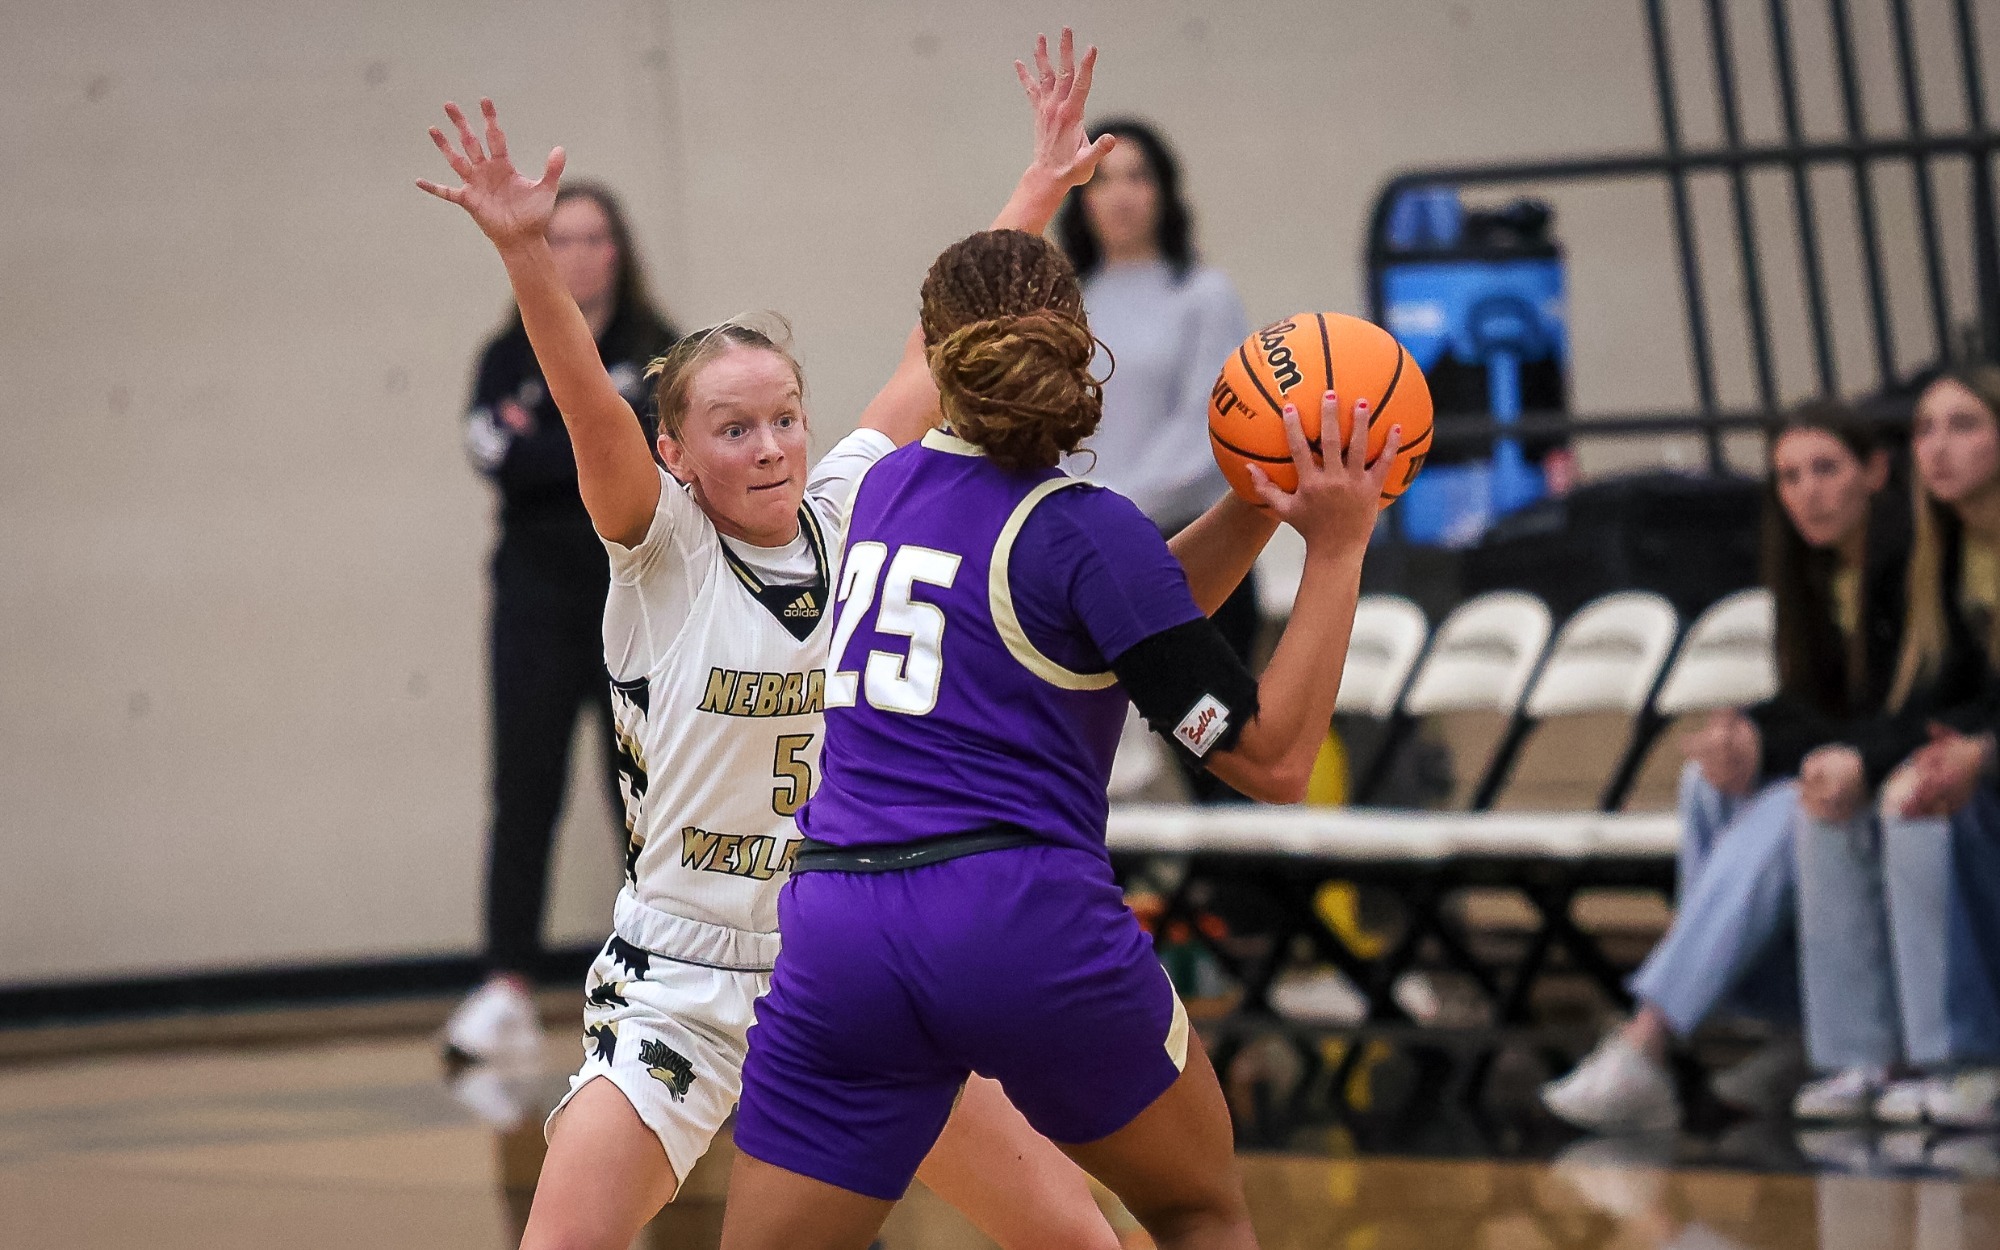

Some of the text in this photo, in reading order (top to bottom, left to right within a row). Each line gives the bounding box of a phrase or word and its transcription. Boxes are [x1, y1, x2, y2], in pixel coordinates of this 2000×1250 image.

[783, 608, 820, 618] adidas
[824, 541, 962, 716] 25
[697, 667, 826, 717] NEBRA
[1188, 706, 1218, 746] Sully
[772, 734, 815, 817] 5
